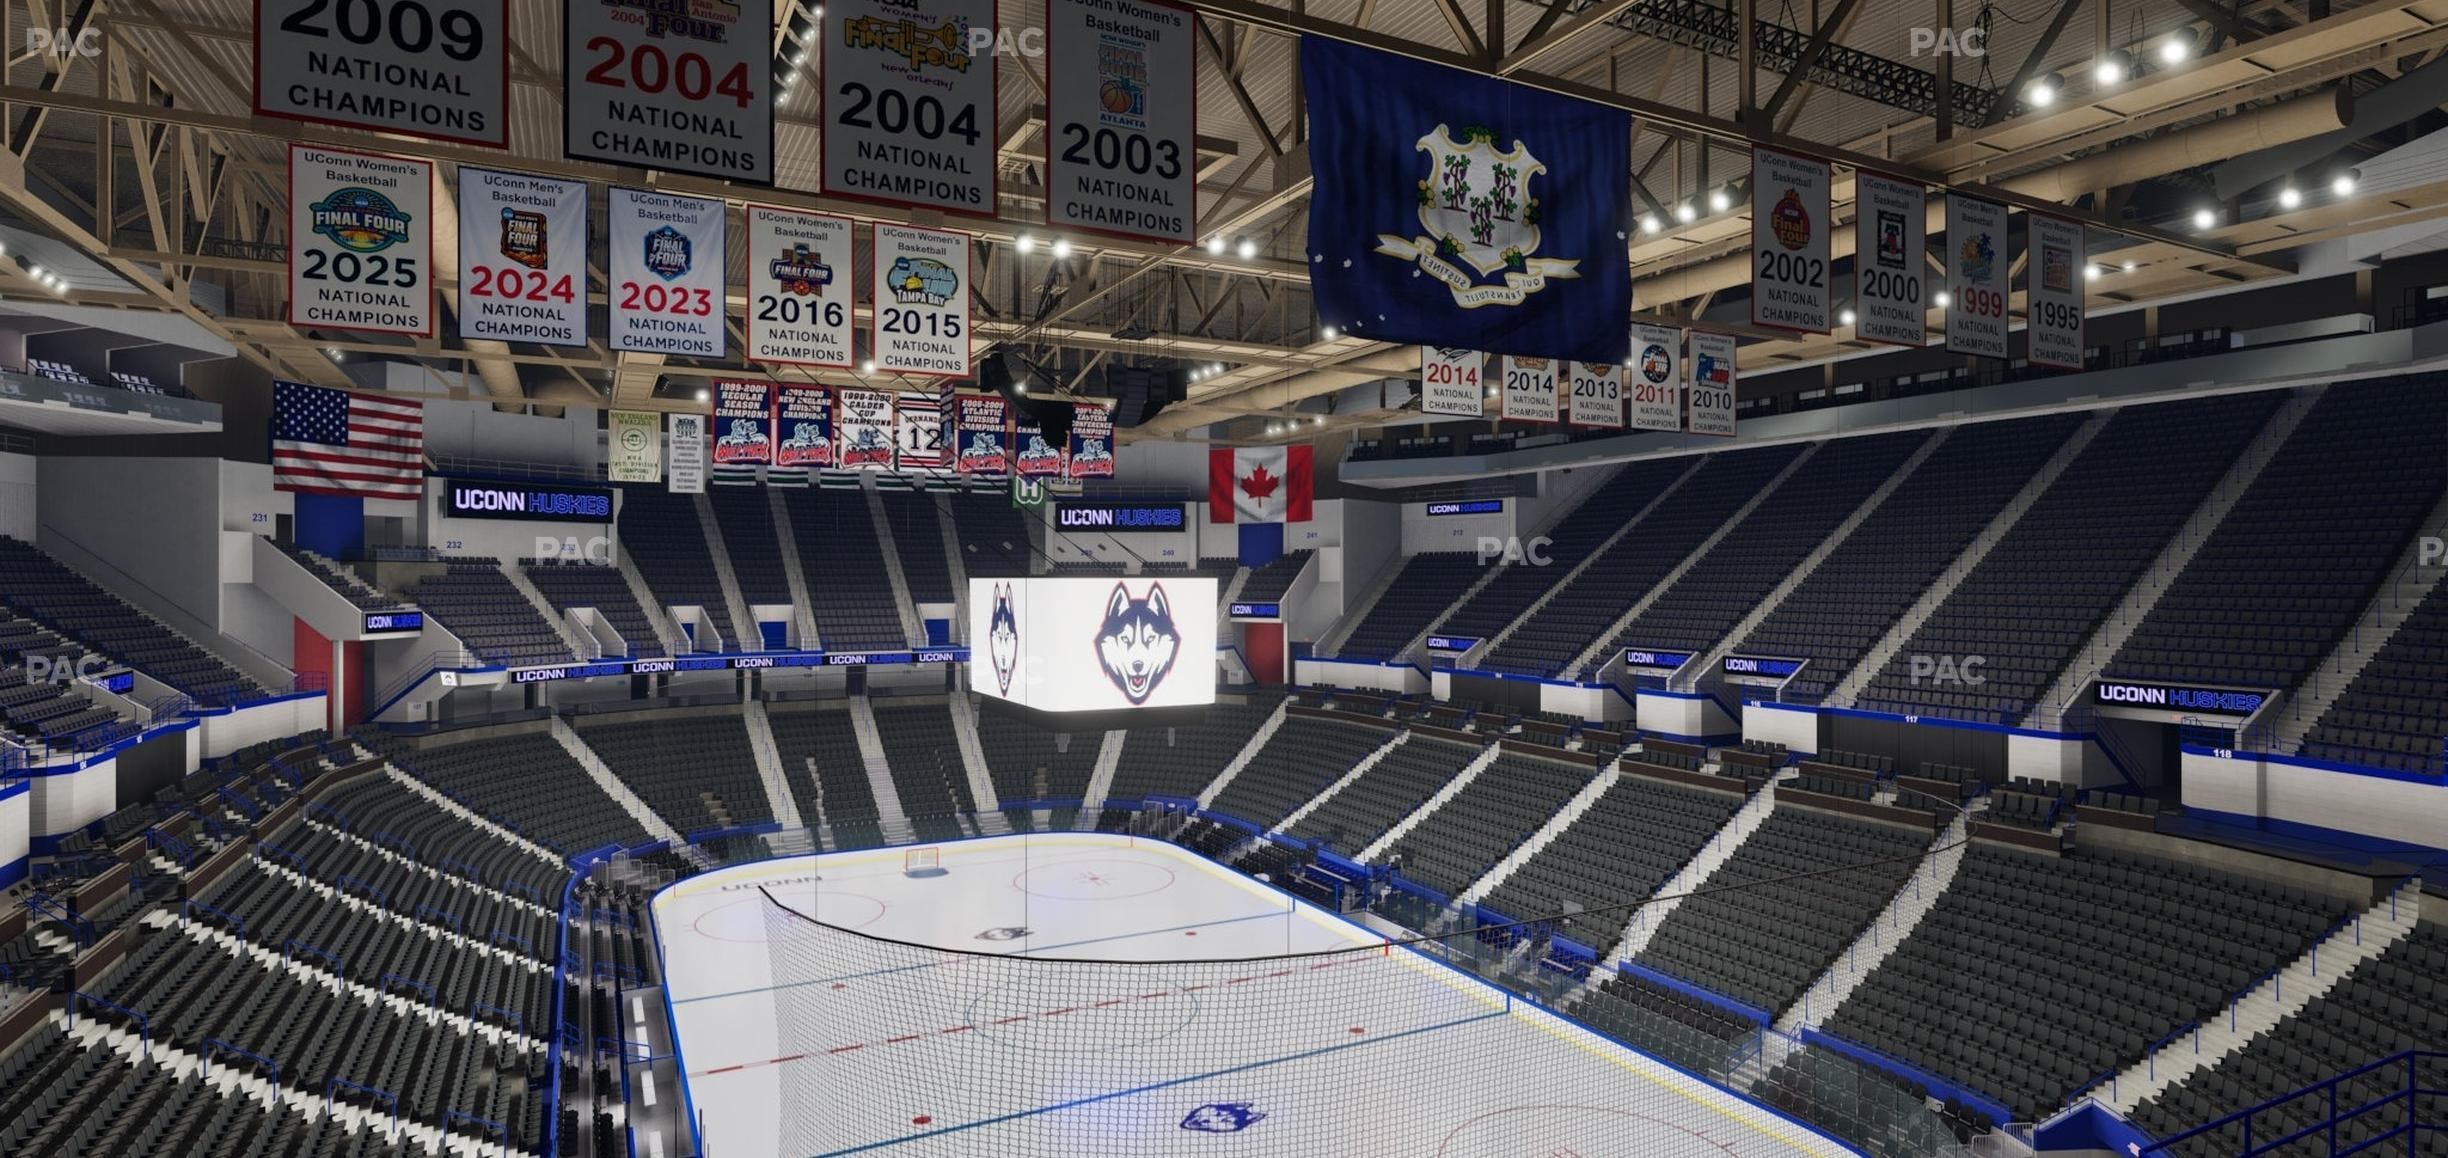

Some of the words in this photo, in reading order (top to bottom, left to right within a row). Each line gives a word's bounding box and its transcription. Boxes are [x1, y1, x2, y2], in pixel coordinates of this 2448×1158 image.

[611, 9, 645, 25] 2004
[1118, 0, 1182, 27] Women's
[280, 0, 483, 61] 2009
[1086, 14, 1160, 42] Basketball
[309, 51, 471, 96] NATIONAL
[585, 36, 754, 108] 2004
[288, 84, 485, 131] CHAMPIONS
[839, 82, 981, 146] 2004
[609, 101, 743, 139] NATIONAL
[1100, 113, 1146, 128] ATLANTA
[592, 131, 754, 171] CHAMPIONS
[858, 141, 971, 174] NATIONAL
[1062, 122, 1182, 180] 2003
[304, 152, 351, 166] UConn
[356, 158, 418, 176] Women's
[326, 169, 397, 188] Basketball
[484, 175, 525, 190] UConn
[530, 179, 564, 195] Men's
[844, 168, 981, 204] CHAMPIONS
[492, 190, 556, 208] Basketball
[1078, 176, 1174, 206] NATIONAL
[630, 193, 669, 207] UConn
[672, 197, 705, 212] Men's
[316, 211, 360, 225] FINAL
[364, 214, 405, 234] FOUR
[638, 208, 698, 224] Basketball
[758, 211, 794, 224] UConn
[797, 216, 843, 231] Women's
[1066, 202, 1182, 233] CHAMPIONS
[508, 219, 538, 234] FINAL
[775, 227, 828, 241] Basketball
[507, 231, 538, 246] FOUR
[653, 238, 684, 252] FINAL
[883, 228, 915, 240] UConn
[918, 232, 961, 246] Women's
[898, 242, 946, 256] Basketball
[302, 249, 417, 288] 2025
[775, 264, 802, 277] FINAL
[803, 267, 829, 280] FOUR
[1760, 250, 1824, 288] 2002
[469, 265, 575, 304] 2024
[1863, 269, 1919, 303] 2000
[318, 288, 411, 308] NATIONAL
[620, 282, 712, 317] 2023
[897, 290, 926, 303] TAMPA
[928, 293, 945, 305] BAY
[1768, 288, 1820, 307] NATIONAL
[1953, 286, 2002, 319] 1999
[307, 308, 419, 328] CHAMPIONS
[482, 302, 566, 321] NATIONAL
[758, 295, 844, 327] 2016
[1762, 306, 1825, 327] CHAMPIONS
[1870, 304, 1917, 323] NATIONAL
[2034, 300, 2080, 331] 1995
[475, 320, 572, 340] CHAMPIONS
[629, 318, 707, 334] NATIONAL
[882, 308, 961, 338] 2015
[1958, 319, 1999, 336] NATIONAL
[769, 328, 839, 344] NATIONAL
[1864, 323, 1921, 341] CHAMPIONS
[2038, 332, 2076, 348] NATIONAL
[622, 335, 713, 351] CHAMPIONS
[892, 340, 956, 355] NATIONAL
[1953, 336, 2003, 353] CHAMPIONS
[761, 345, 845, 361] CHAMPIONS
[2035, 348, 2080, 364] CHAMPIONS
[885, 355, 962, 371] CHAMPIONS
[1427, 363, 1478, 386] 2014
[1507, 370, 1554, 393] 2014
[720, 383, 767, 393] 1999-2000
[721, 391, 763, 402] REGULAR
[1433, 388, 1475, 399] NATIONAL
[1574, 377, 1618, 400] 2013
[1635, 384, 1675, 405] 2011
[724, 400, 761, 410] SEASON
[1428, 400, 1479, 412] CHAMPIONS
[1512, 395, 1551, 406] NATIONAL
[1579, 401, 1615, 412] NATIONAL
[1693, 389, 1732, 410] 2010
[715, 408, 769, 420] CHAMPIONS
[1508, 407, 1555, 419] CHAMPIONS
[1575, 412, 1619, 424] CHAMPIONS
[1640, 406, 1674, 417] NATIONAL
[1697, 411, 1729, 422] NATIONAL
[1636, 417, 1677, 429] CHAMPIONS
[1693, 423, 1732, 433] CHAMPIONS
[455, 488, 525, 511] UCONN
[529, 492, 609, 516] HUSKIES
[1430, 504, 1459, 514] UCONN
[252, 513, 268, 523] 231
[1061, 509, 1112, 526] UCONN
[1115, 508, 1182, 527] HUSKIES
[446, 541, 462, 549] 232
[1231, 604, 1252, 616] UCONN
[367, 615, 393, 630] UCONN
[1428, 637, 1449, 648] UCONN
[734, 658, 773, 668] UCONN
[830, 655, 866, 665] UCONN
[919, 653, 953, 662] UCONN
[1627, 652, 1655, 664] UCONN
[1725, 658, 1757, 672] UCONN
[516, 668, 565, 682] UCONN
[633, 661, 674, 673] UCONN
[2100, 683, 2165, 704] UCONN
[2169, 688, 2262, 712] HUSKIES
[1905, 715, 1919, 724] 117
[2213, 749, 2232, 760] 118
[722, 875, 823, 891] UCONN
